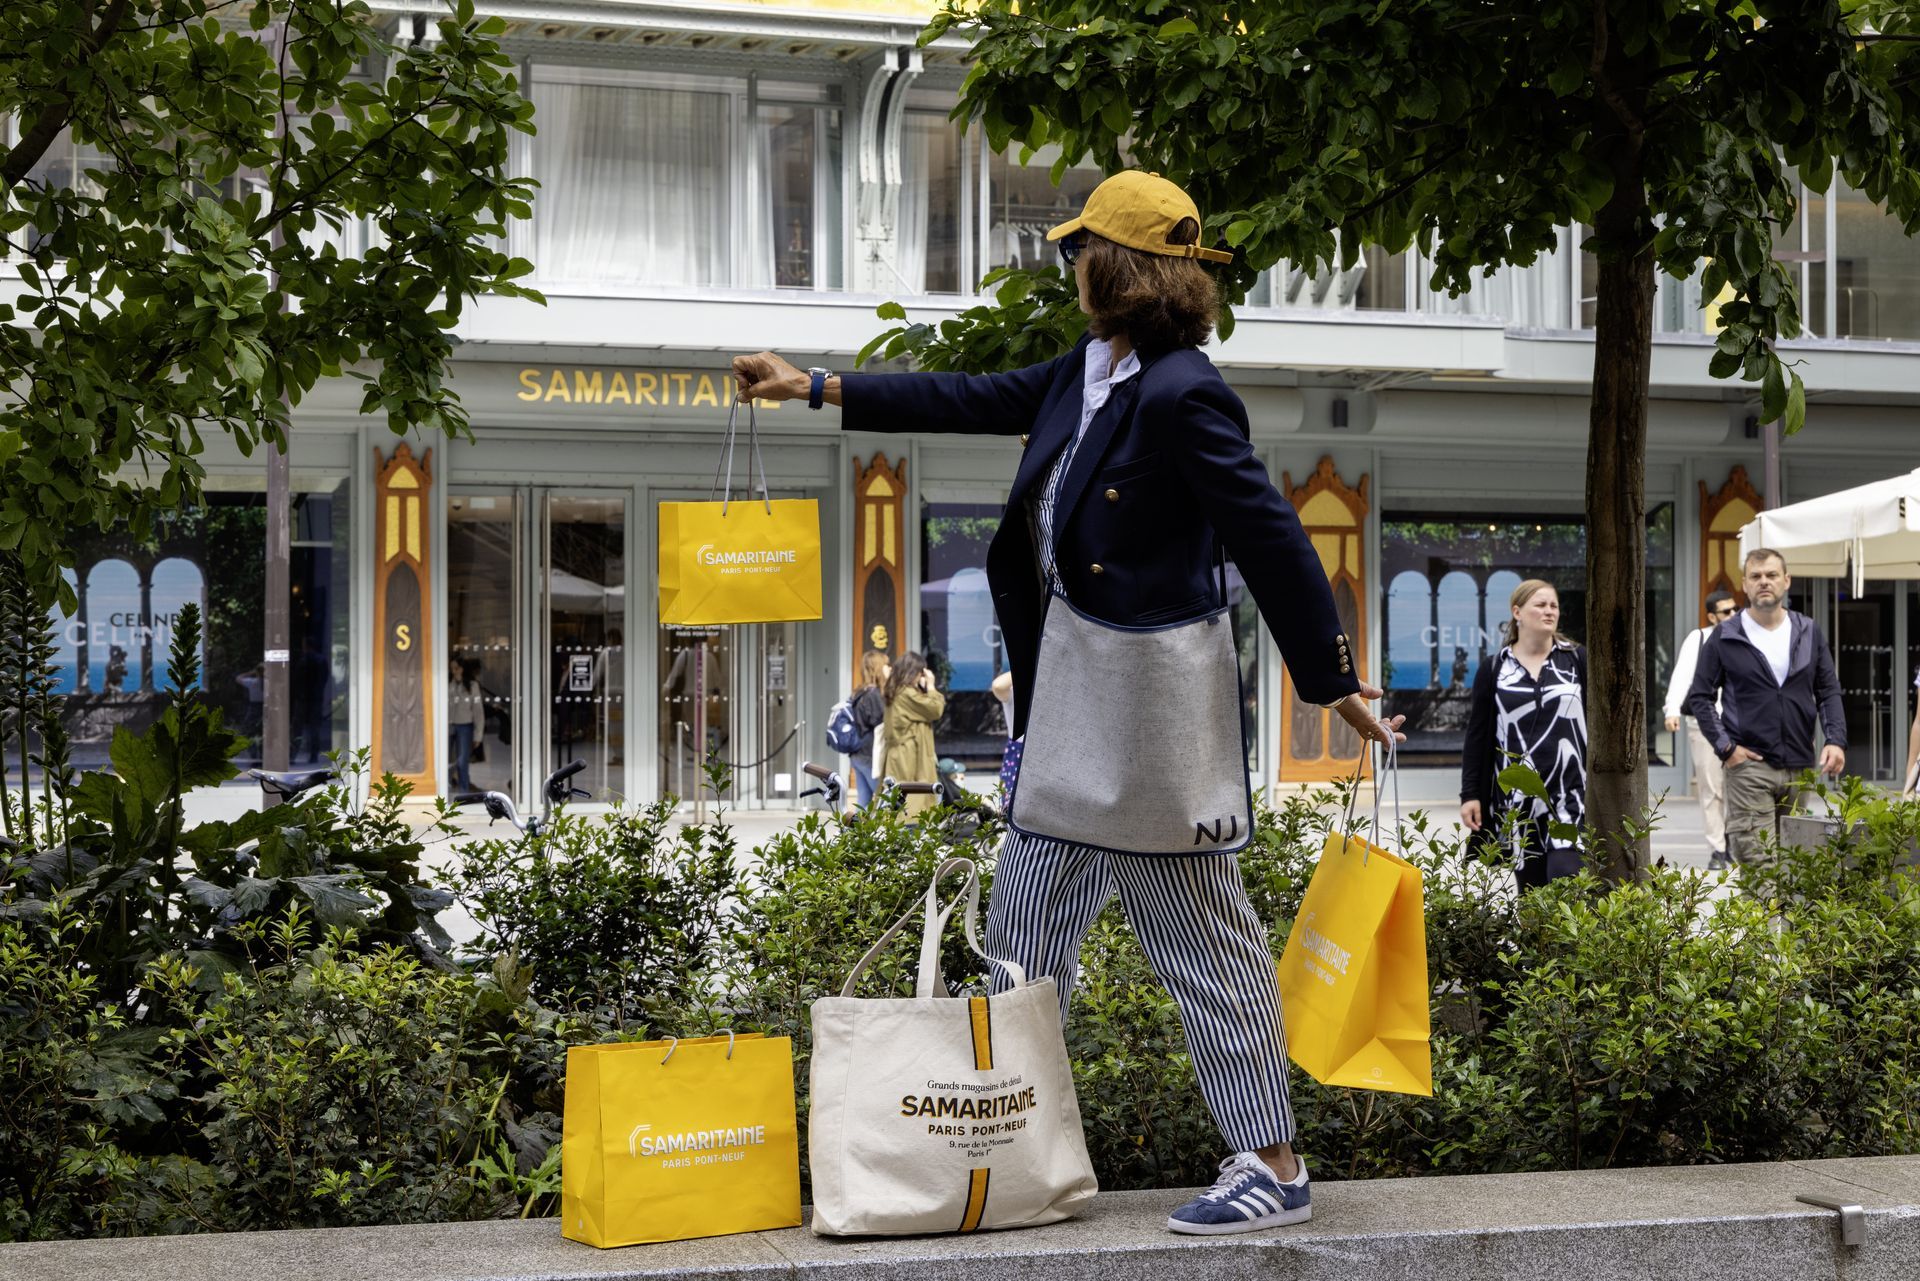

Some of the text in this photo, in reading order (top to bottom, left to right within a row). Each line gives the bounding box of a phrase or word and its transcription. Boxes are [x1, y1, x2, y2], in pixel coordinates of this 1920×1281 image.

[517, 369, 781, 409] SAMARITAI
[705, 550, 796, 565] SAMARITAINE
[64, 621, 173, 647] CELIN
[1420, 625, 1505, 648] CELIN
[1193, 815, 1237, 845] NJ
[1302, 927, 1351, 975] SAMARITAINE
[927, 1080, 960, 1090] Grands
[961, 1083, 999, 1094] magasins
[1000, 1080, 1009, 1089] de
[900, 1086, 1037, 1120] SAMARITAINE
[928, 1118, 1027, 1136] PARIS PONT-NEUF
[640, 1125, 766, 1157] SAMARITAINE
[971, 1141, 980, 1149] de
[981, 1140, 988, 1148] la
[662, 1151, 745, 1169] PARIS PONT-NEUF
